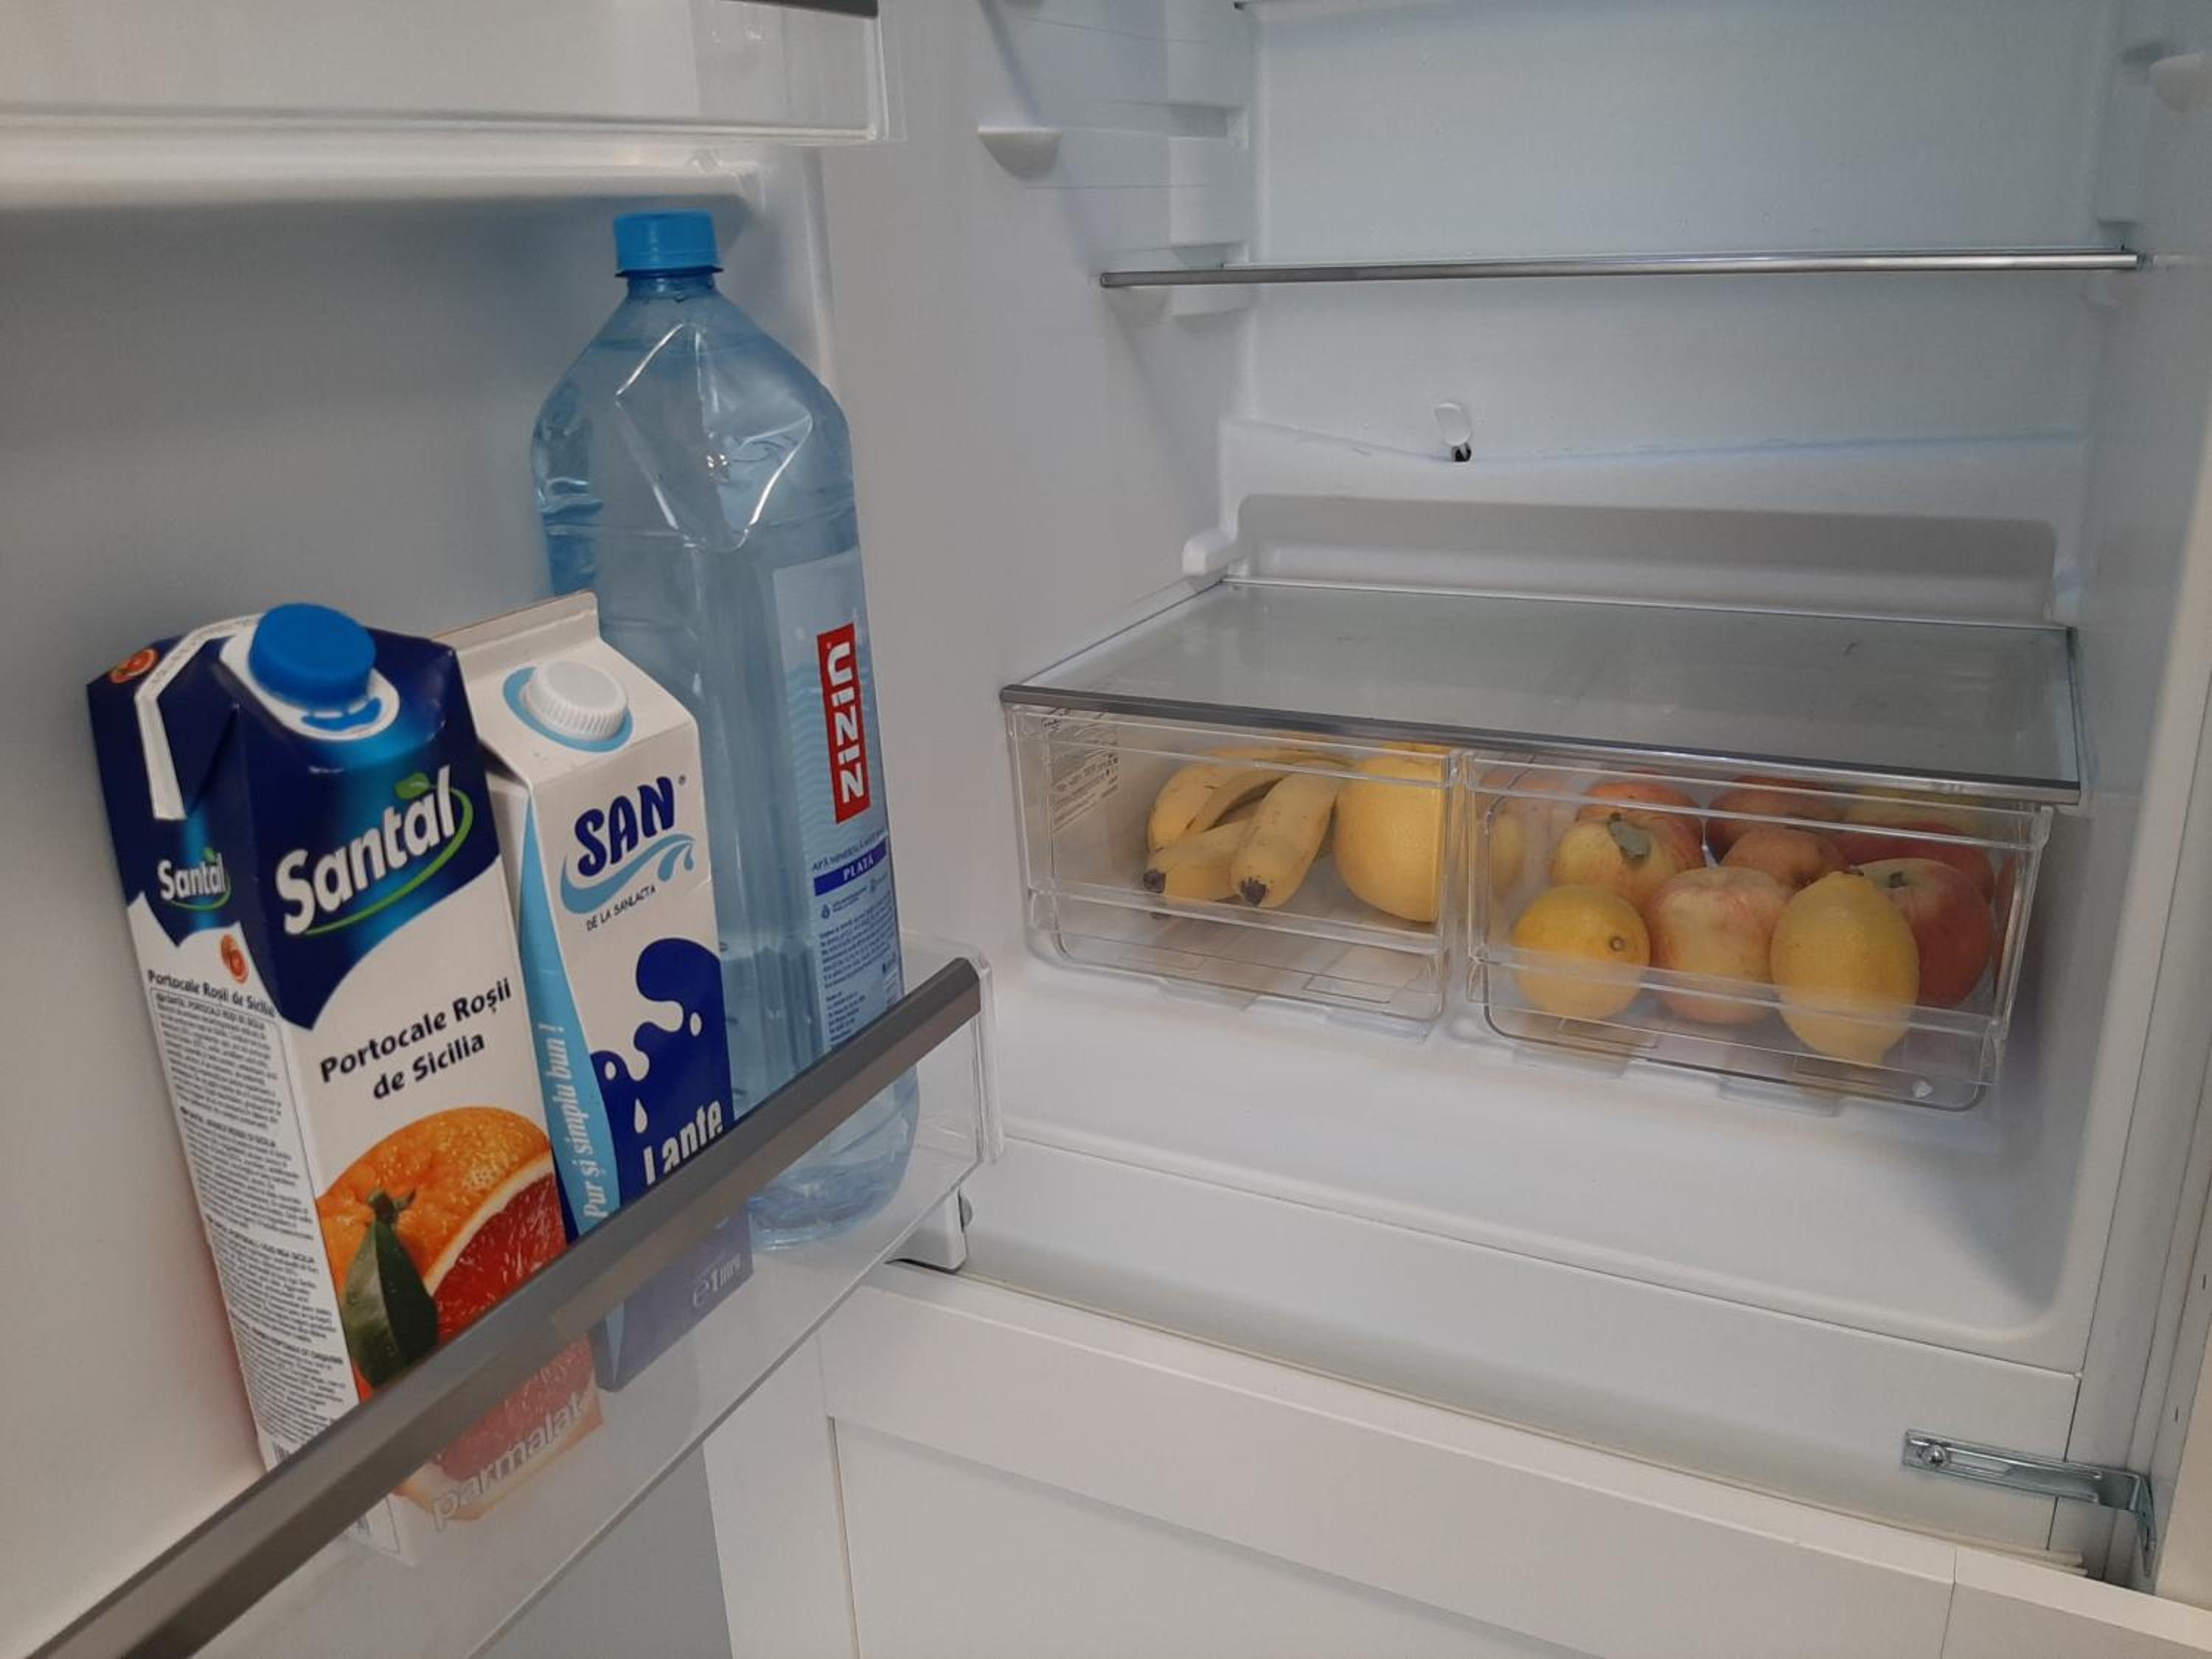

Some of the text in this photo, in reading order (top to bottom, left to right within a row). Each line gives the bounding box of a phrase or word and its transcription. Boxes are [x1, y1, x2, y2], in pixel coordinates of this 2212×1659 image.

[575, 776, 675, 877] SAN
[586, 916, 598, 931] DE
[600, 906, 611, 923] LA
[319, 1012, 447, 1083] Portocale
[452, 977, 512, 1022] Roșii
[372, 1033, 485, 1099] de Sicilia
